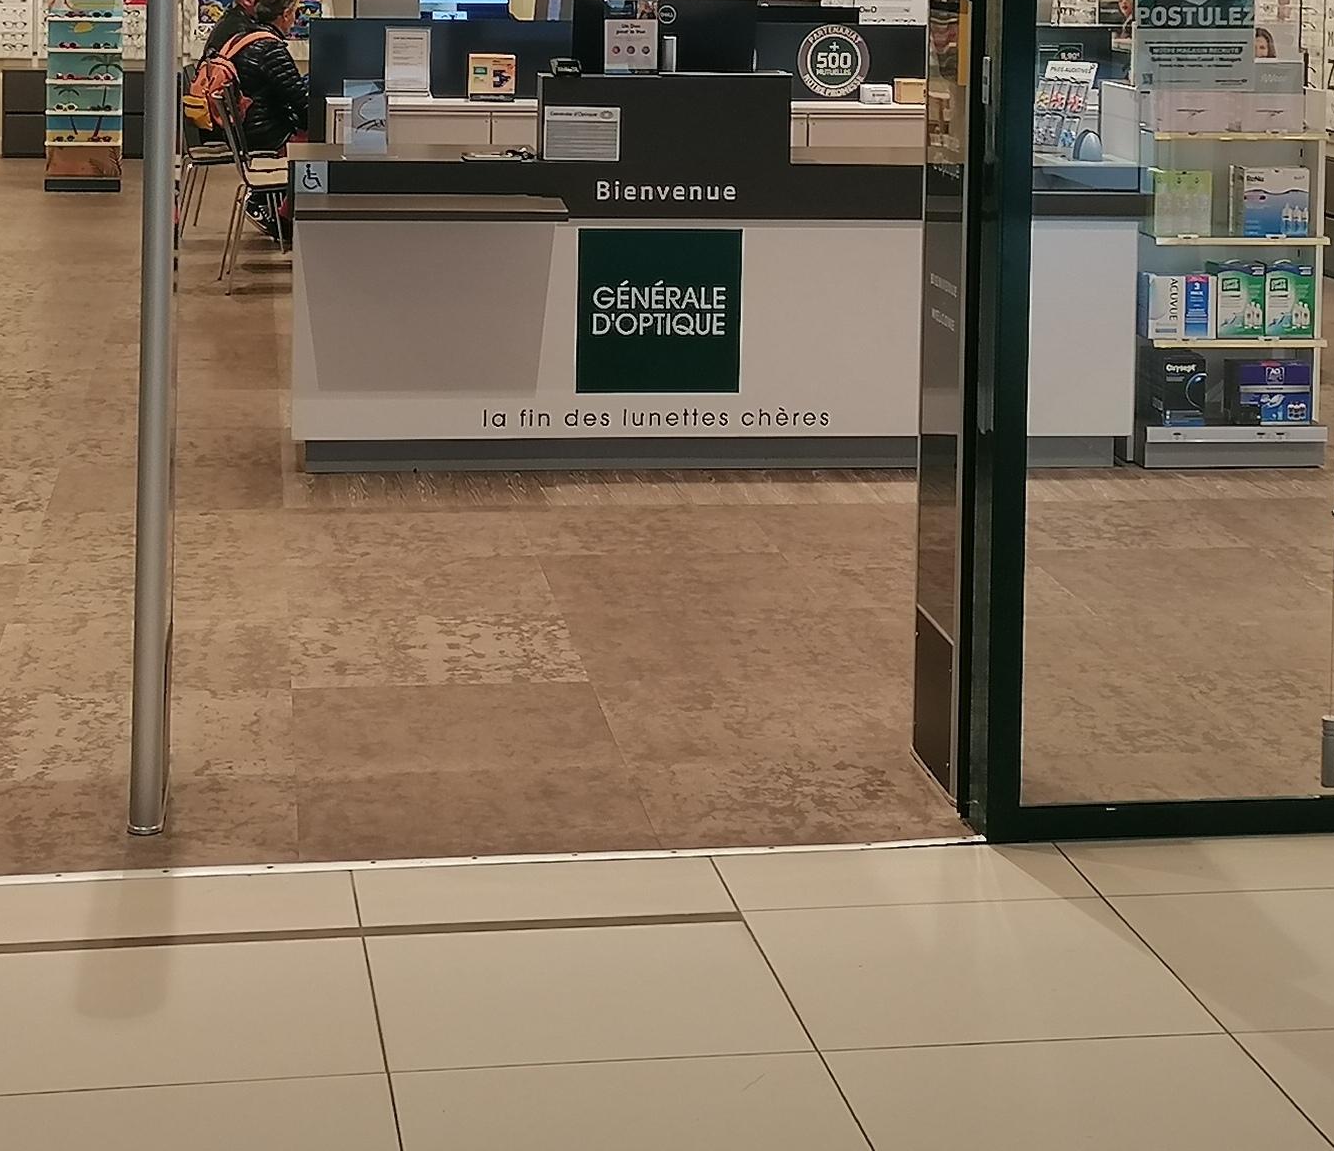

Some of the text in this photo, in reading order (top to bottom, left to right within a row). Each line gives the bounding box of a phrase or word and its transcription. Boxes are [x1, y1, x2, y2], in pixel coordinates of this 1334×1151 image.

[1138, 6, 1255, 27] POSTULEZ
[816, 52, 852, 69] 500
[595, 180, 737, 201] Bienvenue
[592, 280, 727, 310] GÉNÉRALE
[1169, 277, 1178, 321] ACUVUE
[591, 313, 726, 336] D'OPTIQUE
[482, 408, 830, 428] la fin des lunettes chères
